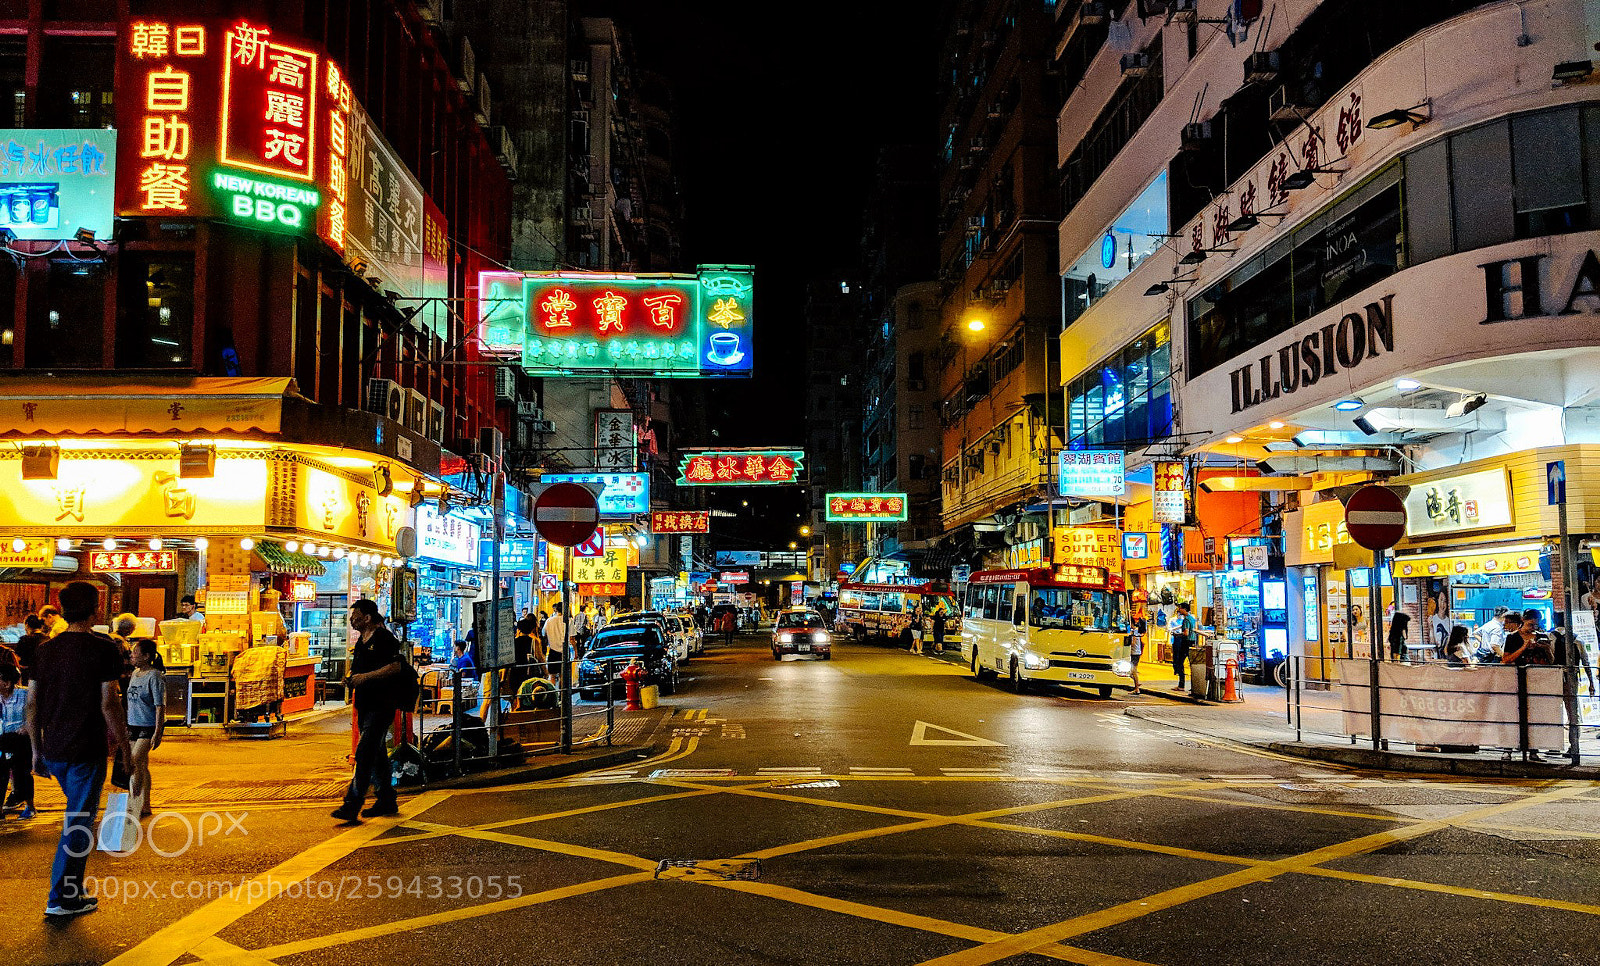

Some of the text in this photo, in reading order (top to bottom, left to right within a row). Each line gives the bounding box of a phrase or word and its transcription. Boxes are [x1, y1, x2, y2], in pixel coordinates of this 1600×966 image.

[131, 22, 206, 58] 韓日
[140, 66, 191, 212] 自助餐
[0, 140, 108, 177] 汽水任飲
[216, 173, 319, 206] NEW KOREAN
[232, 194, 302, 227] BBQ
[1229, 293, 1395, 414] ILLUSION
[607, 416, 624, 472] 金華冰
[664, 514, 707, 531] 找換店
[1062, 534, 1117, 542] SUPER
[1062, 545, 1116, 553] OUTLET
[577, 568, 622, 580] 找換店
